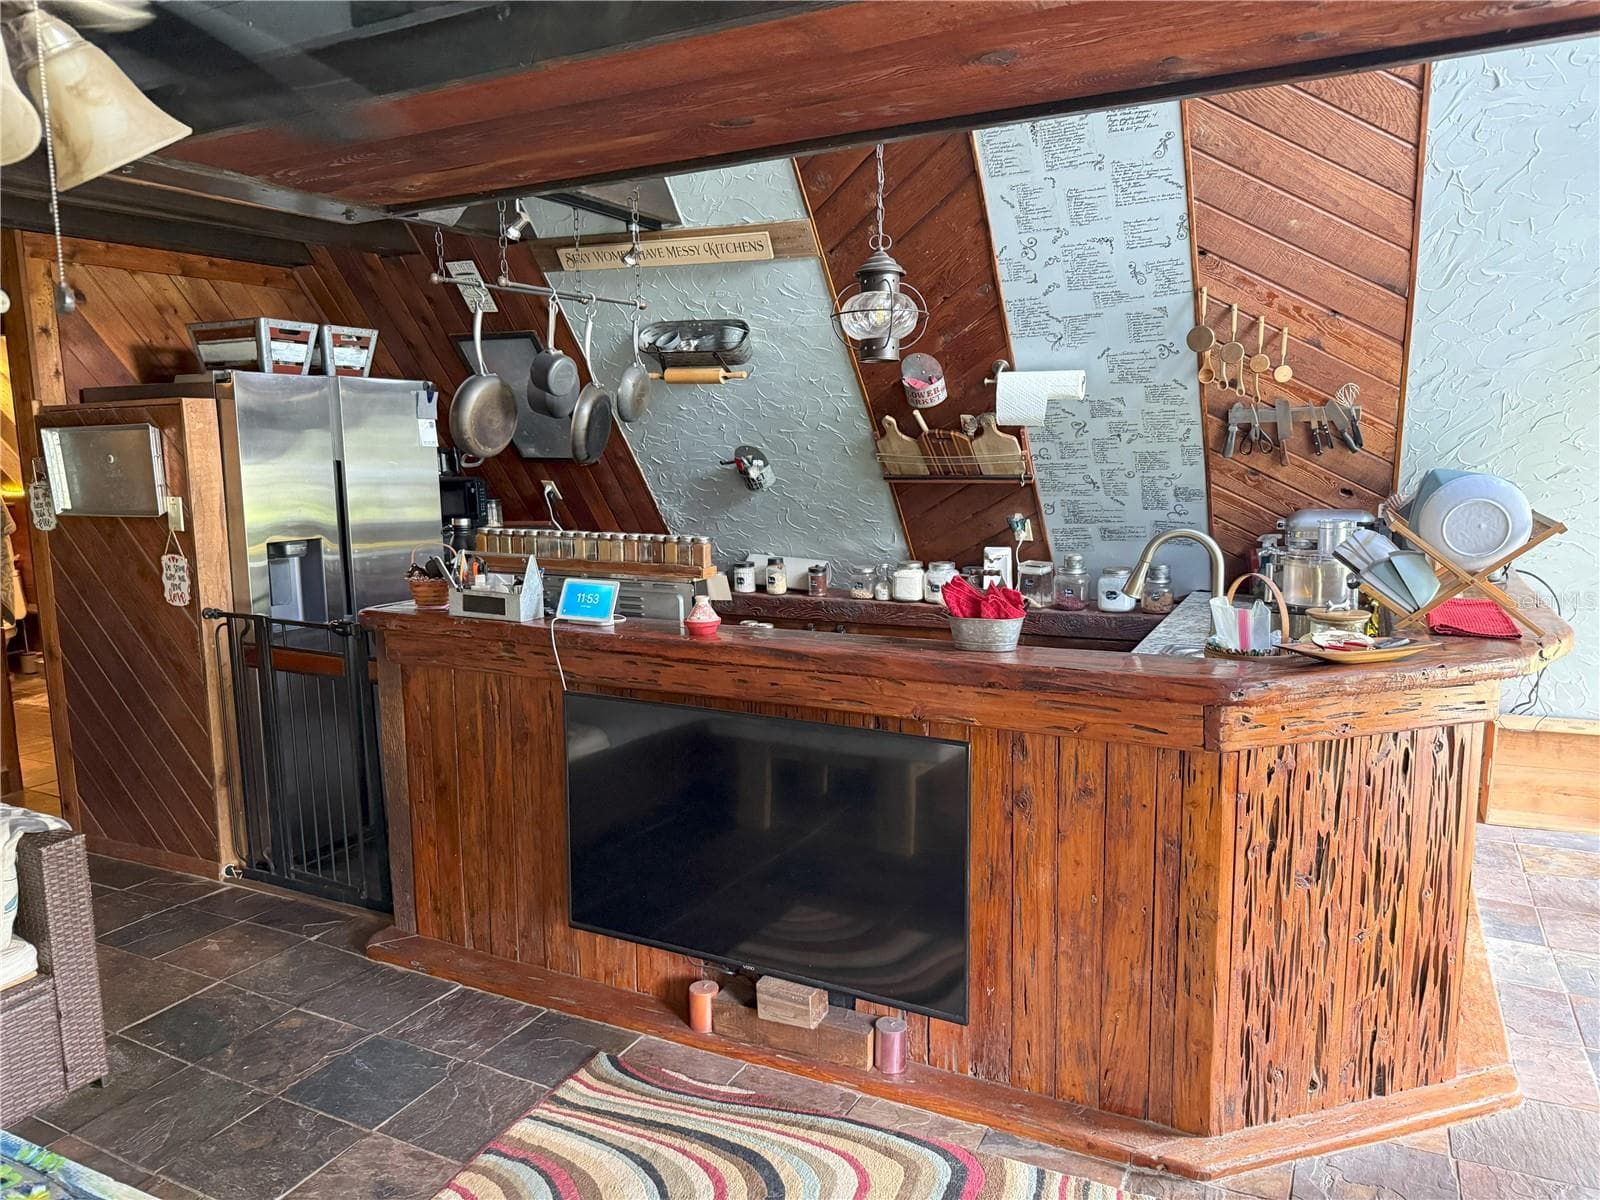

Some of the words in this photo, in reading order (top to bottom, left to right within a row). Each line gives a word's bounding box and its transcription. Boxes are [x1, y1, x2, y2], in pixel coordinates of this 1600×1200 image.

[592, 249, 629, 263] WOME
[665, 244, 701, 260] MESSY
[703, 240, 765, 259] KITCHENS
[576, 592, 600, 605] 11:53
